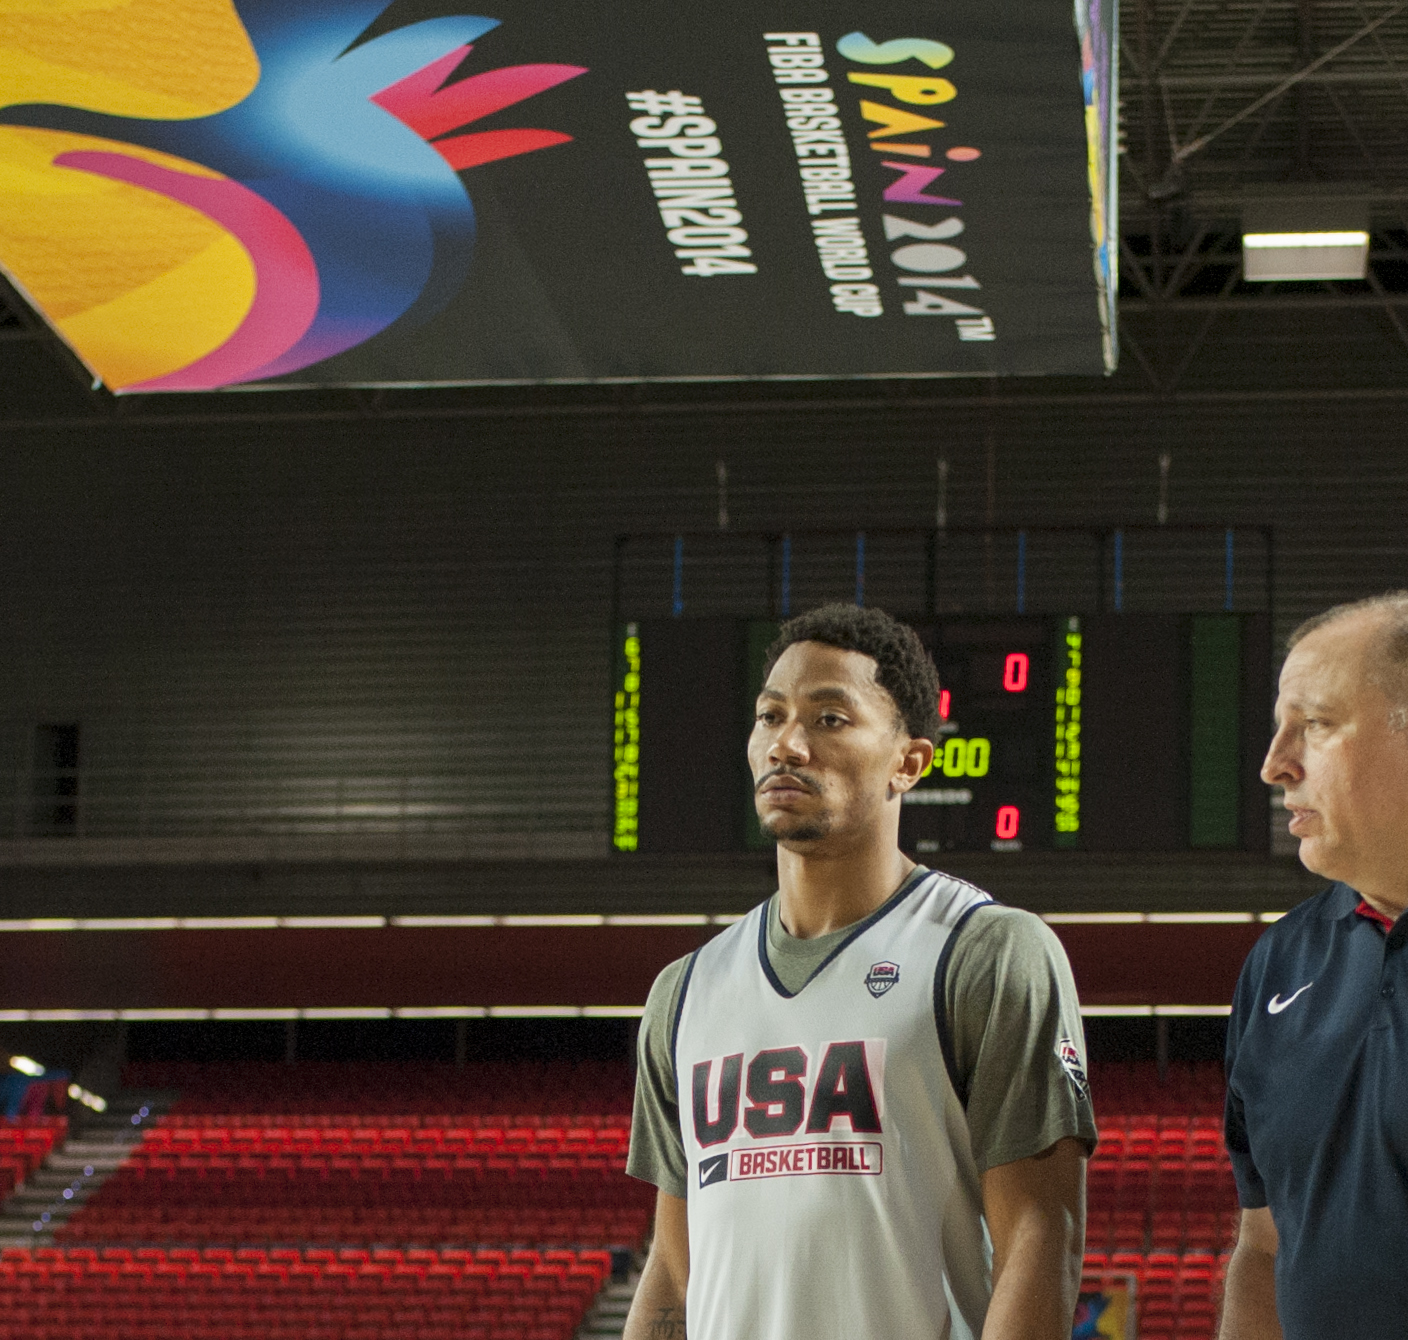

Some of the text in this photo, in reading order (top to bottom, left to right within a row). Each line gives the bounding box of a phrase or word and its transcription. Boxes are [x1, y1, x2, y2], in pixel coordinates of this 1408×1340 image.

[625, 89, 759, 277] #SPAIN2014
[763, 31, 884, 318] FIBA BASKETBALL WORLD CUP
[1003, 652, 1029, 692] 0
[995, 805, 1020, 839] 0
[692, 1040, 883, 1149] USA
[738, 1146, 871, 1176] BASKETBALL
